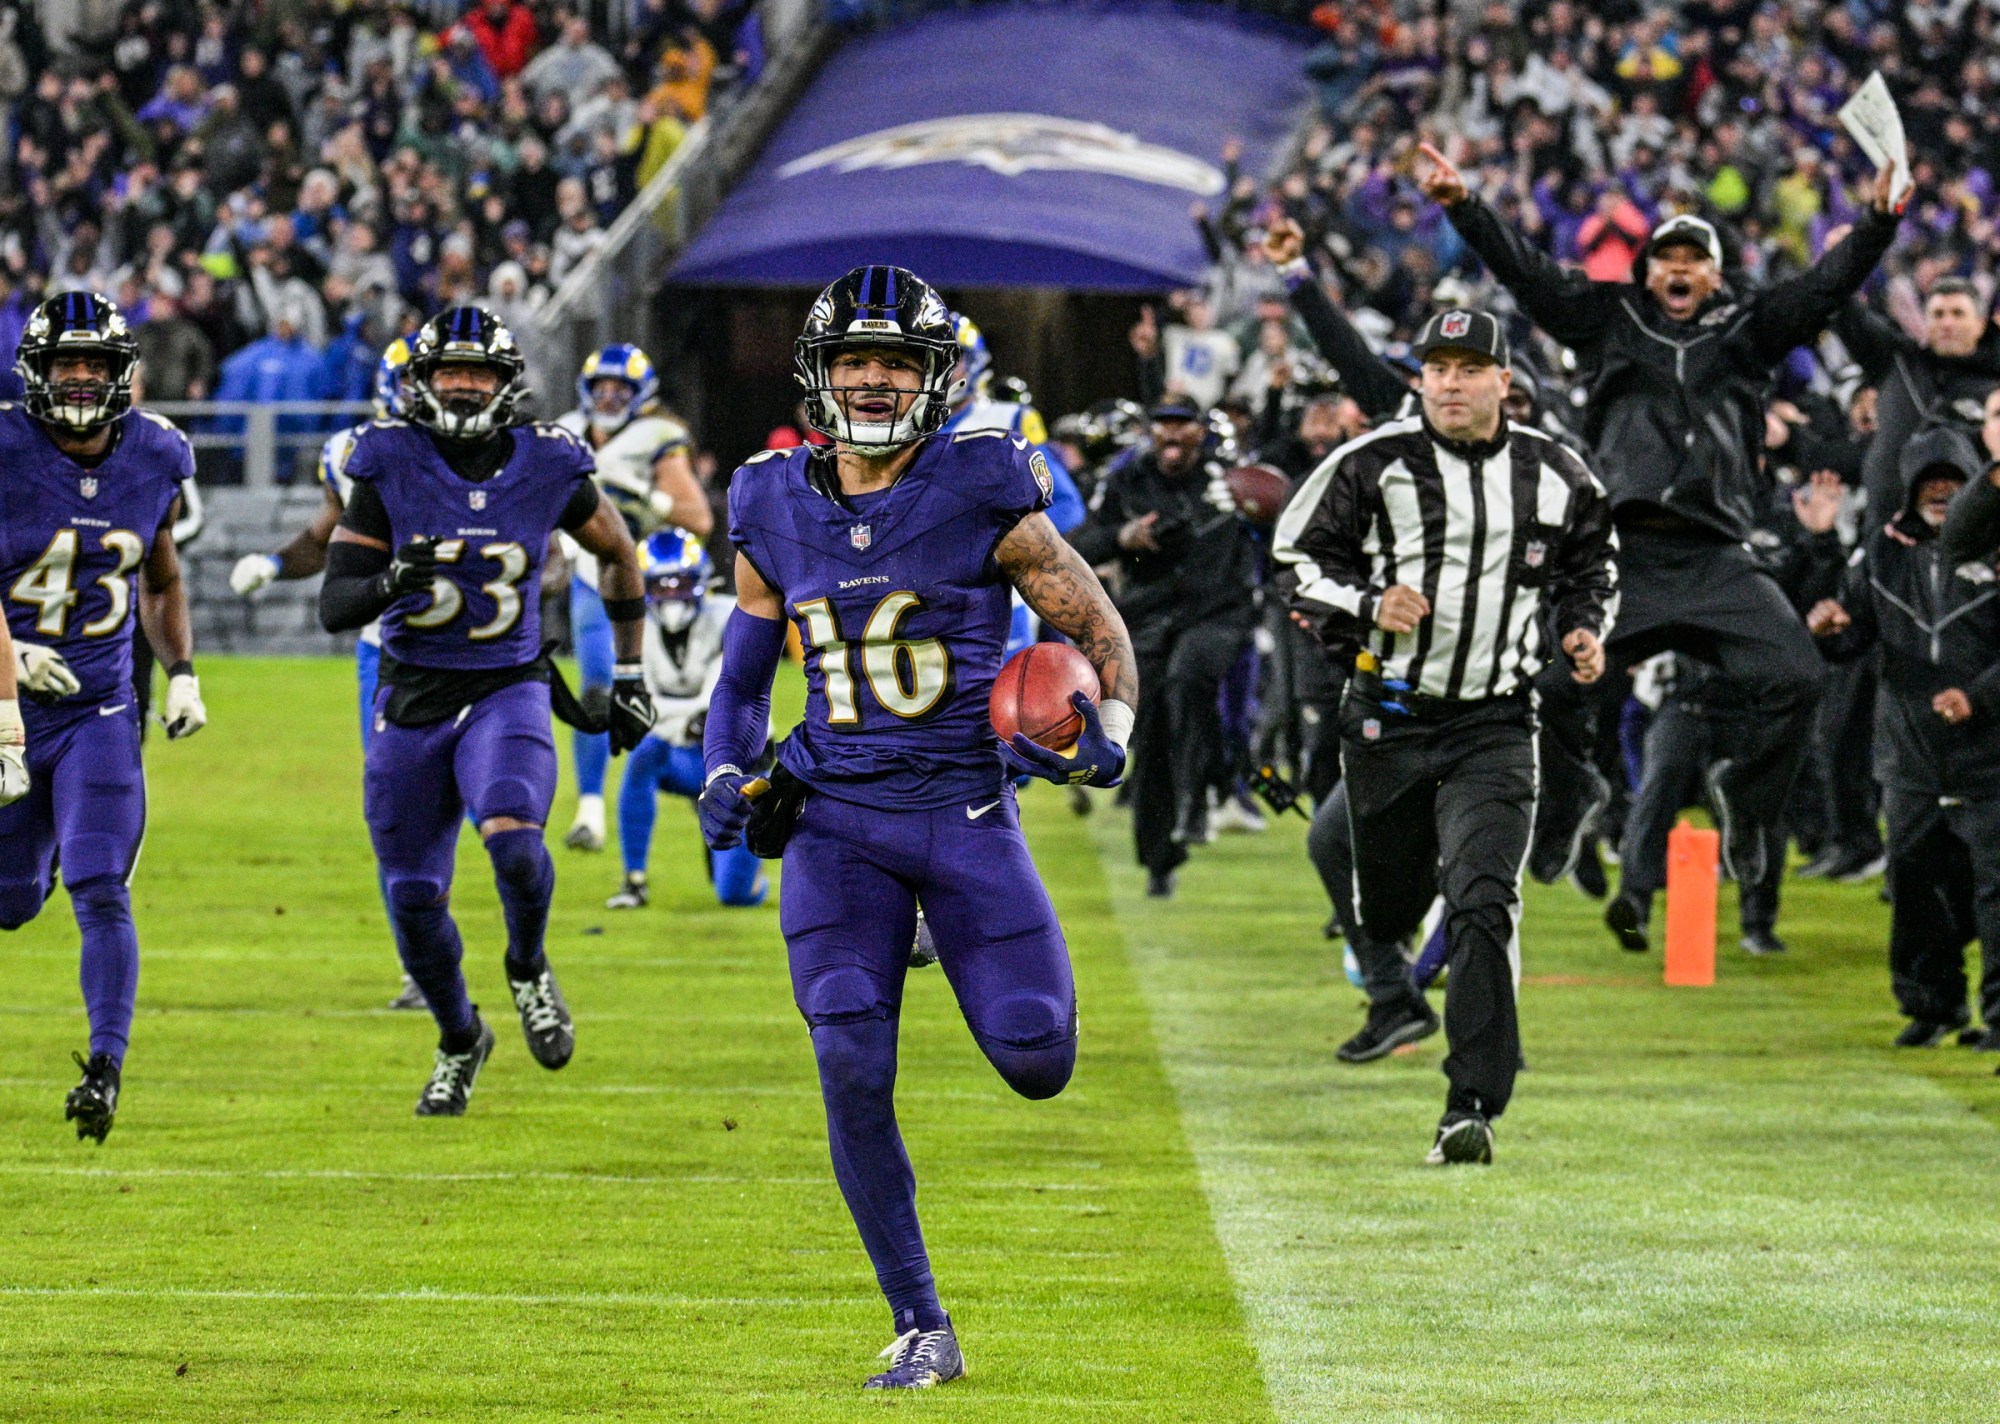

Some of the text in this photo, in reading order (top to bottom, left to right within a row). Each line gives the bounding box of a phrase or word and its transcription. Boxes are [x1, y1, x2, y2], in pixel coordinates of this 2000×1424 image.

[10, 528, 144, 636] 43
[405, 533, 528, 640] 53
[839, 576, 888, 588] RAVENS
[854, 535, 868, 545] NFL
[793, 590, 948, 723] 16
